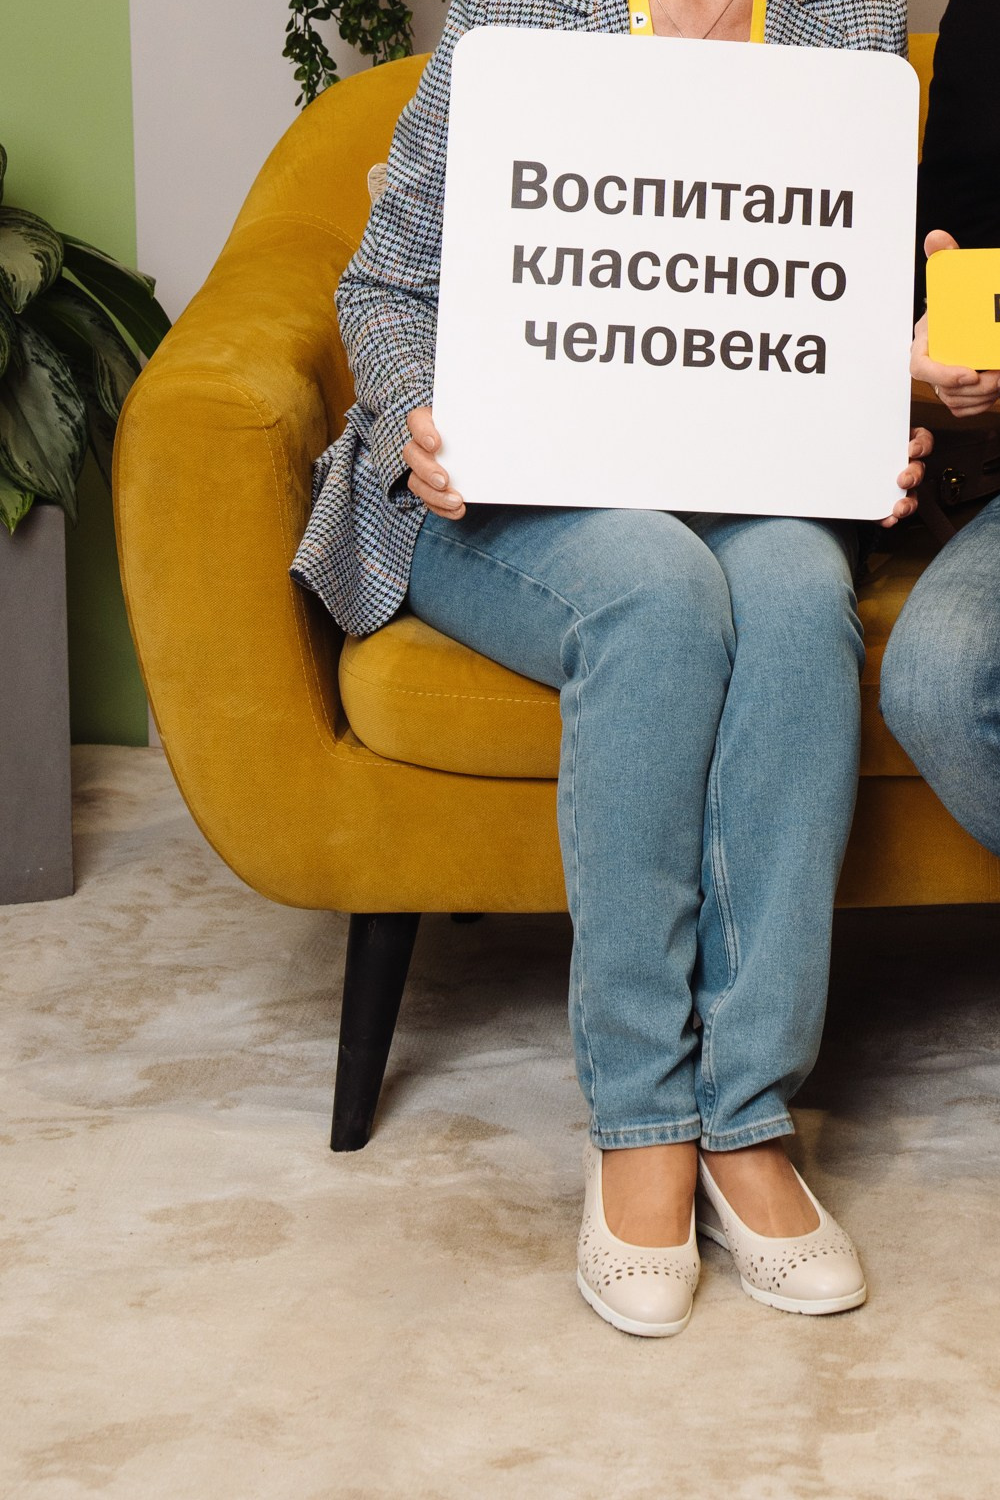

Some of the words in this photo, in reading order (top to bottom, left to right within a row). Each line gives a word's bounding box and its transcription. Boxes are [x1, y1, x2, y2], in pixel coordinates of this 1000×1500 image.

[510, 160, 854, 229] Воспитали
[512, 244, 848, 302] классного
[523, 319, 828, 375] человека
